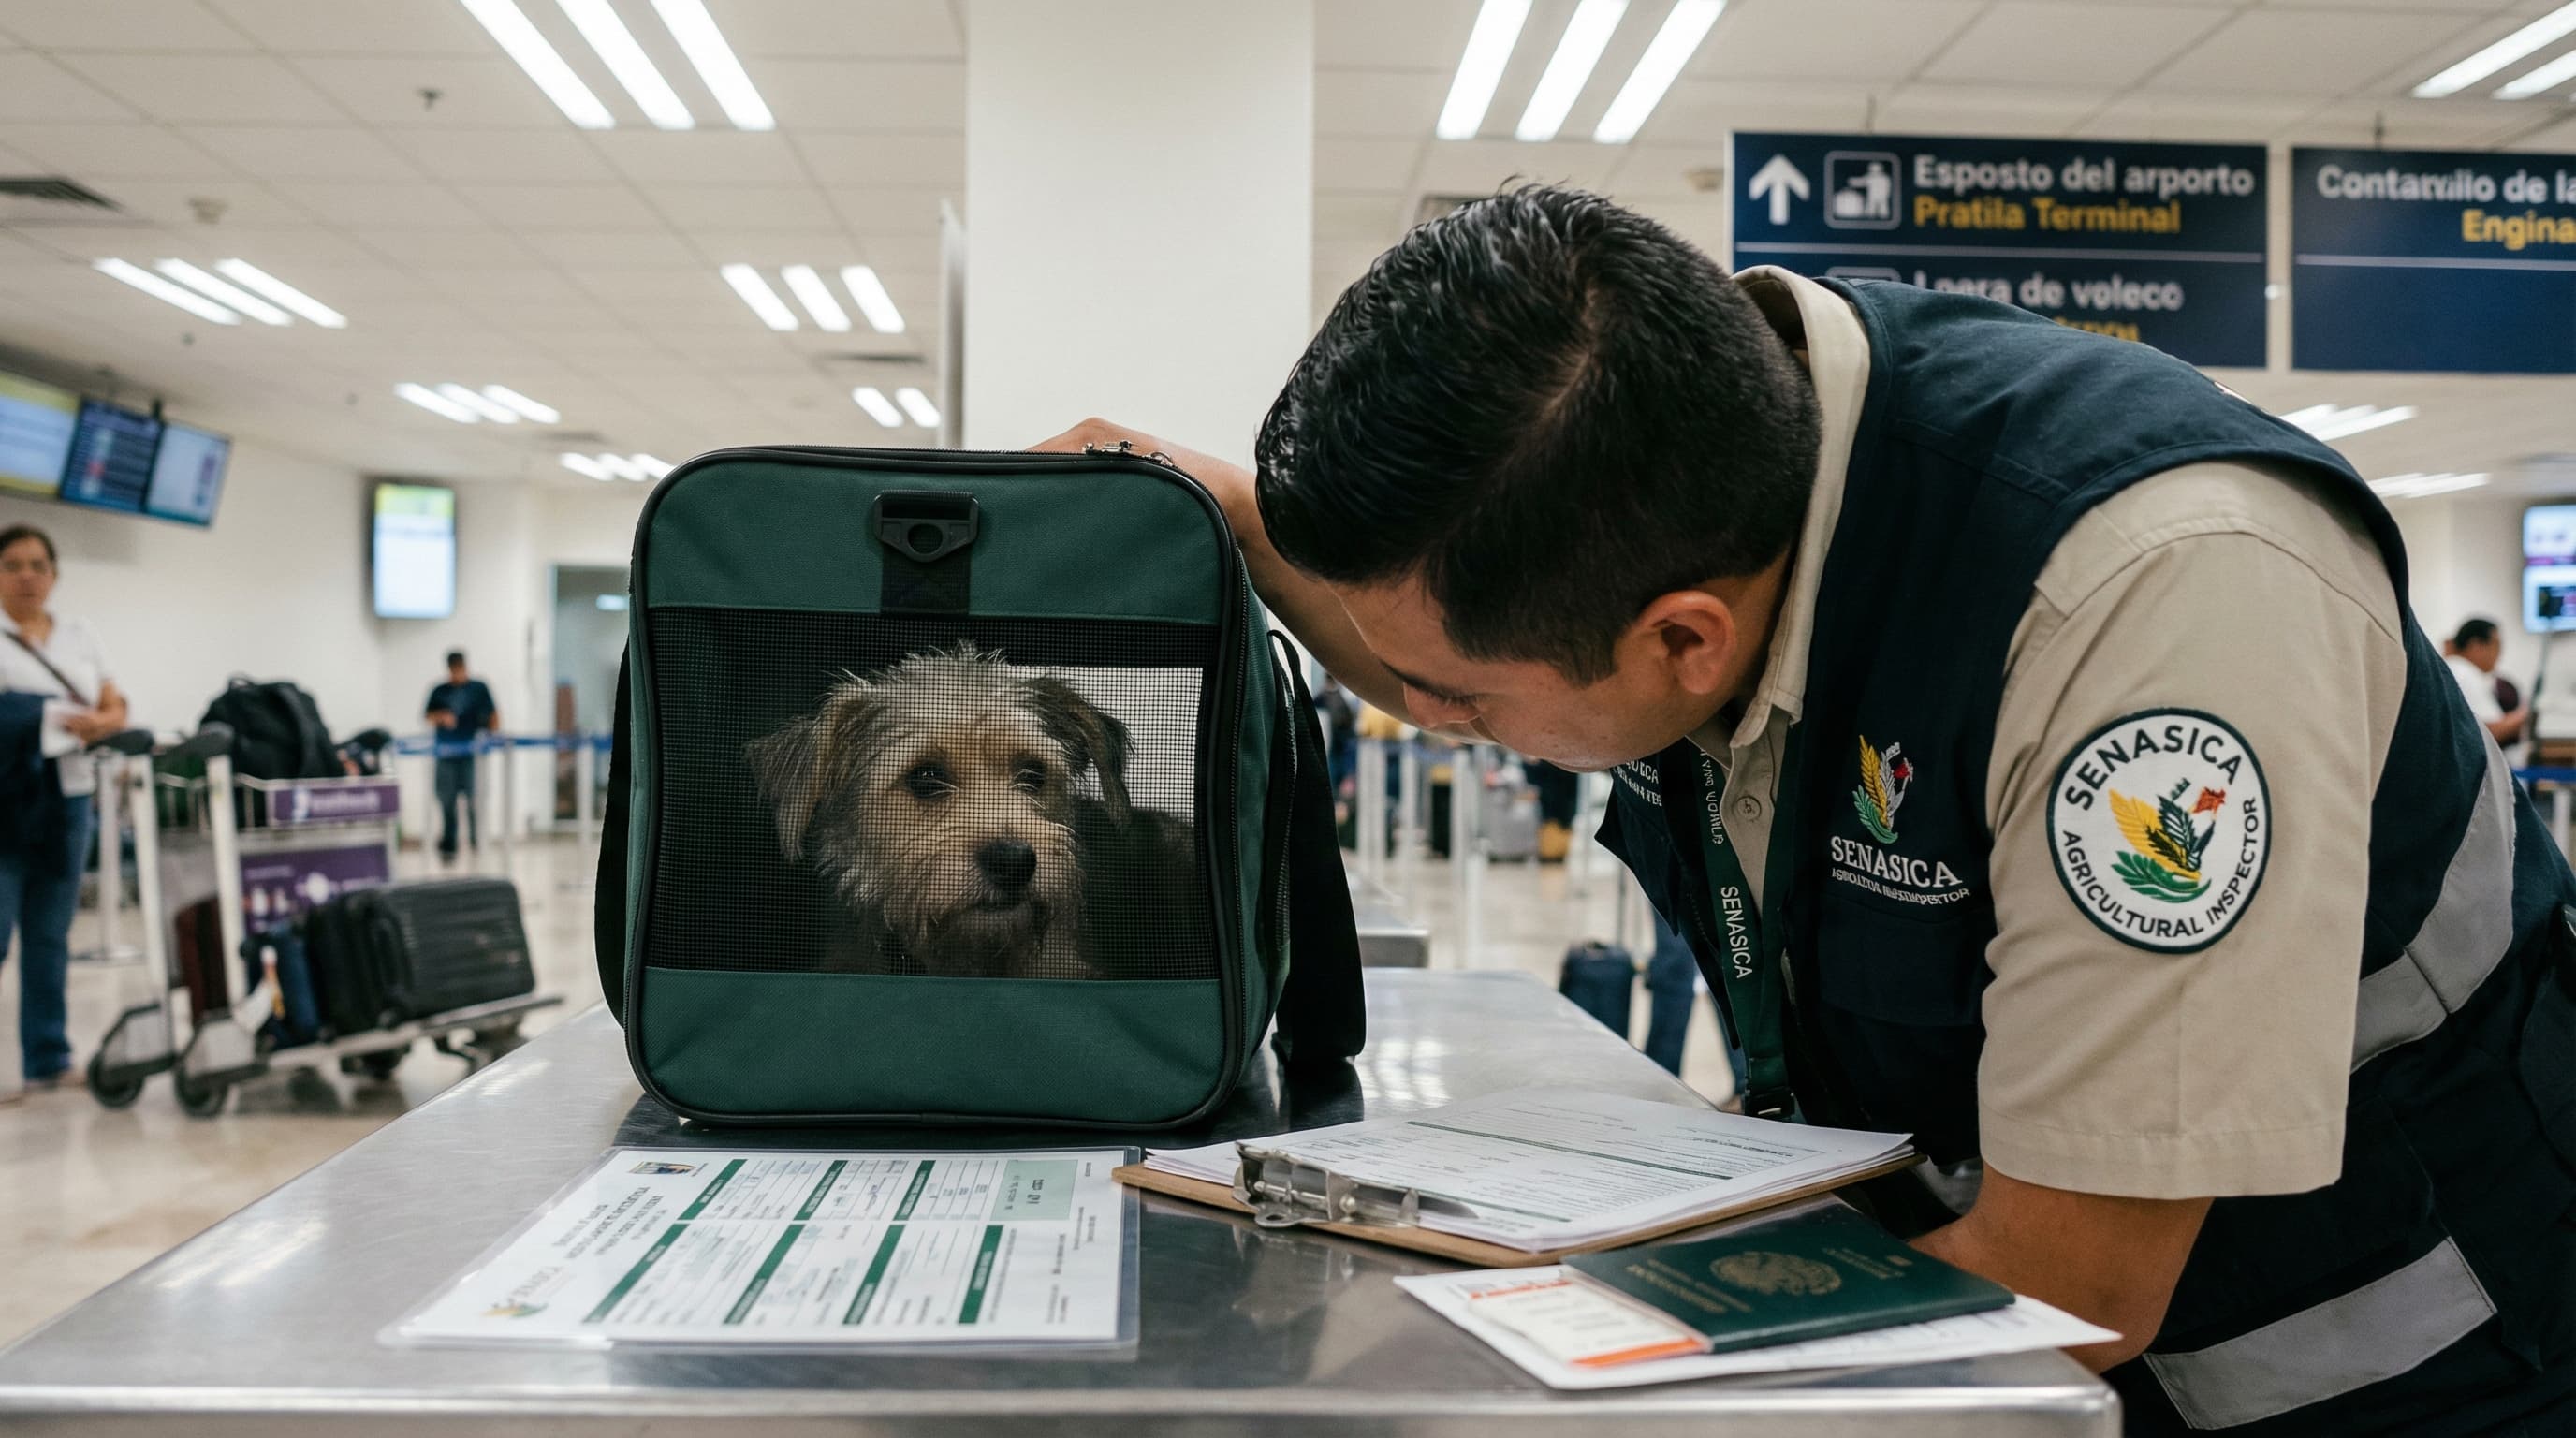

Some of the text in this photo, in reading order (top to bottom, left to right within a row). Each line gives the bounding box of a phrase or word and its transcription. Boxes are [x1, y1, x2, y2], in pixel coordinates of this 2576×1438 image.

[1914, 154, 2254, 200] Esposto del arporto
[2503, 169, 2547, 204] de
[1914, 195, 2181, 233] Pratila Terminal
[2462, 208, 2576, 251] Engina
[2065, 725, 2243, 811] SENASICA
[1831, 836, 1963, 888] SENASICA
[2062, 797, 2259, 938] AGRICULTURAL INSPECTOR
[1720, 886, 1753, 979] SENASICA
